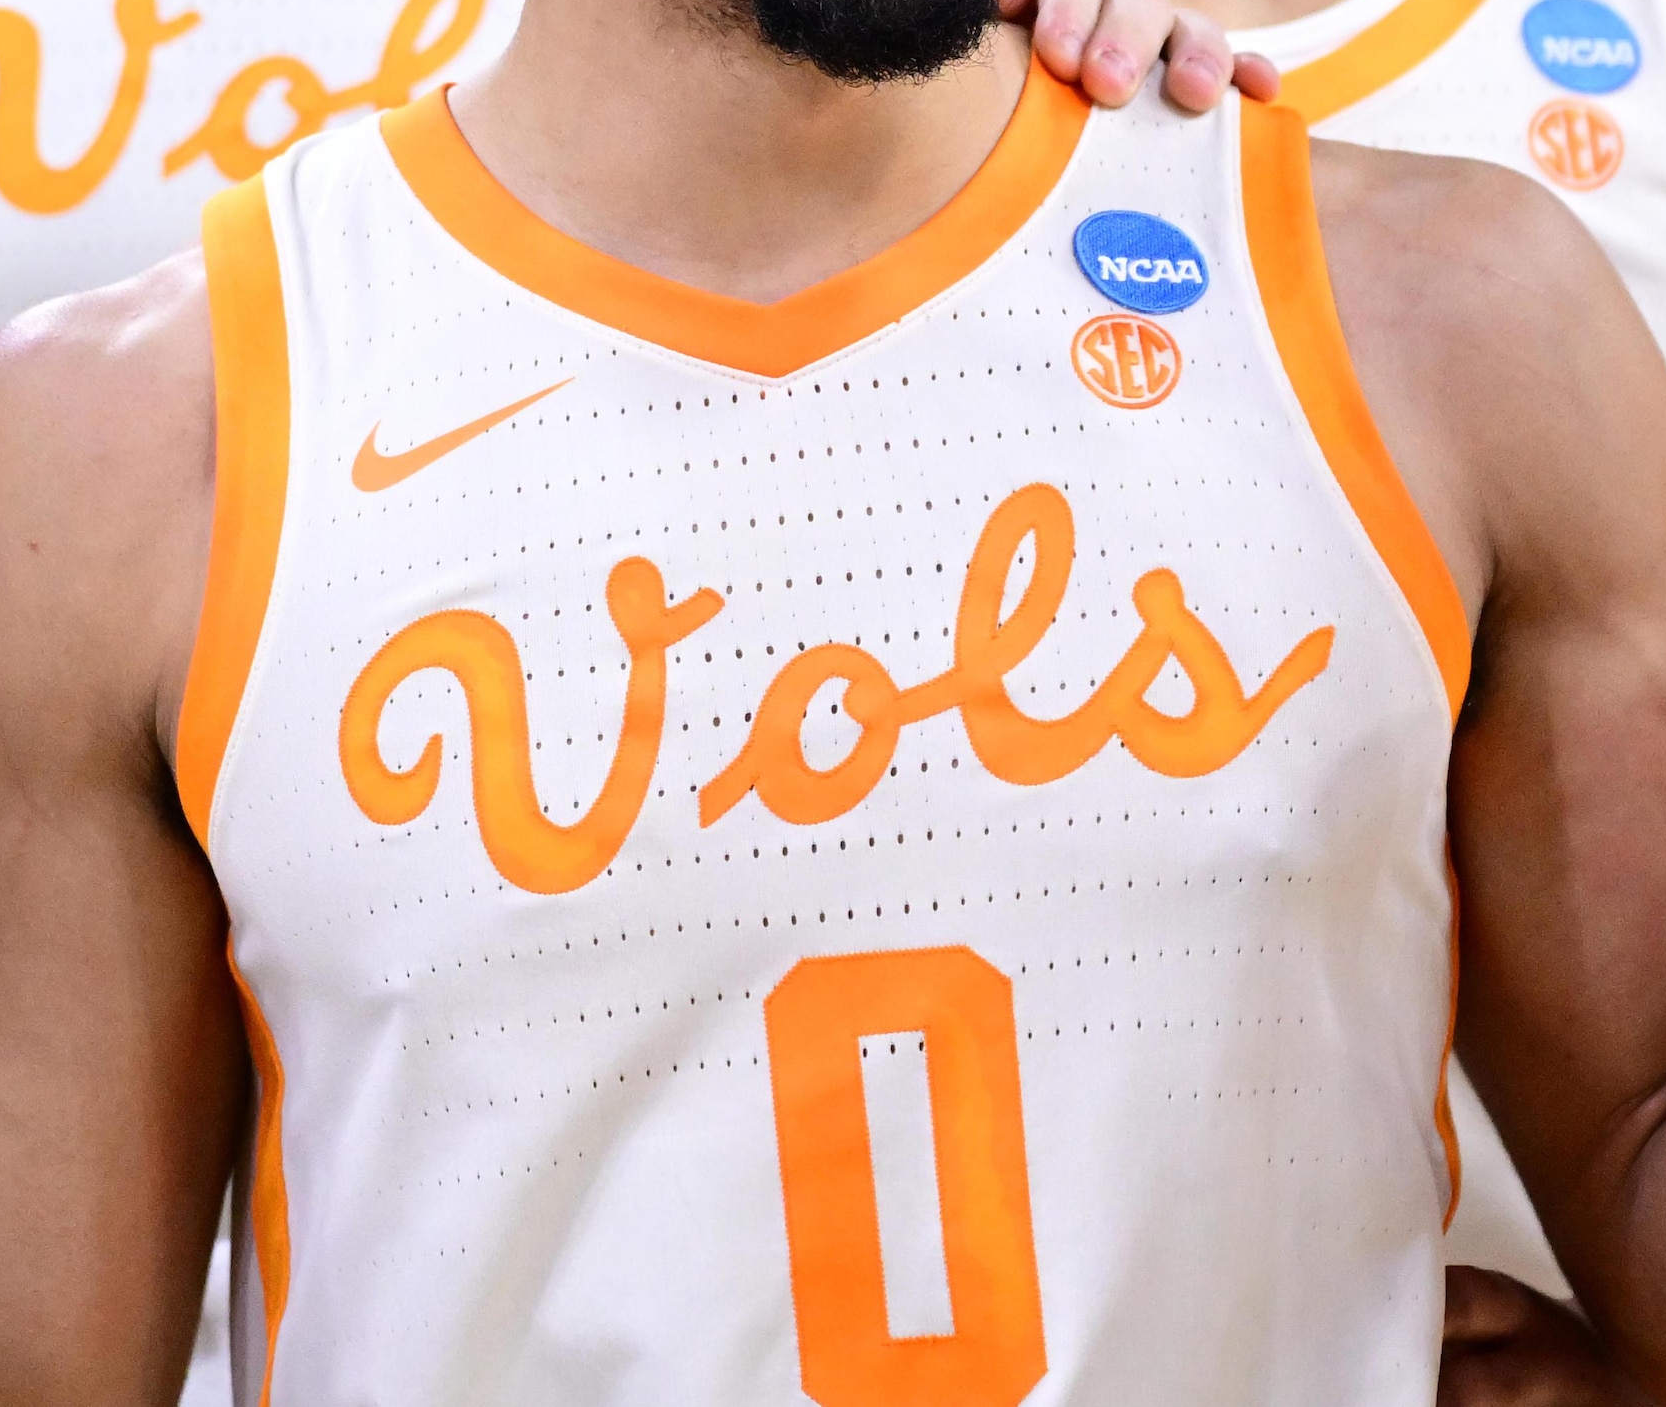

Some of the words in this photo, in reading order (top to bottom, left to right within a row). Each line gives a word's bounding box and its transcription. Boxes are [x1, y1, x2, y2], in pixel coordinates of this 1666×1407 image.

[1542, 35, 1636, 69] NCAA
[1537, 108, 1614, 181] SEC
[1097, 255, 1203, 284] NCAA
[1082, 321, 1173, 398] SEC
[338, 482, 1334, 895] Vols
[764, 944, 1048, 1407] 0
